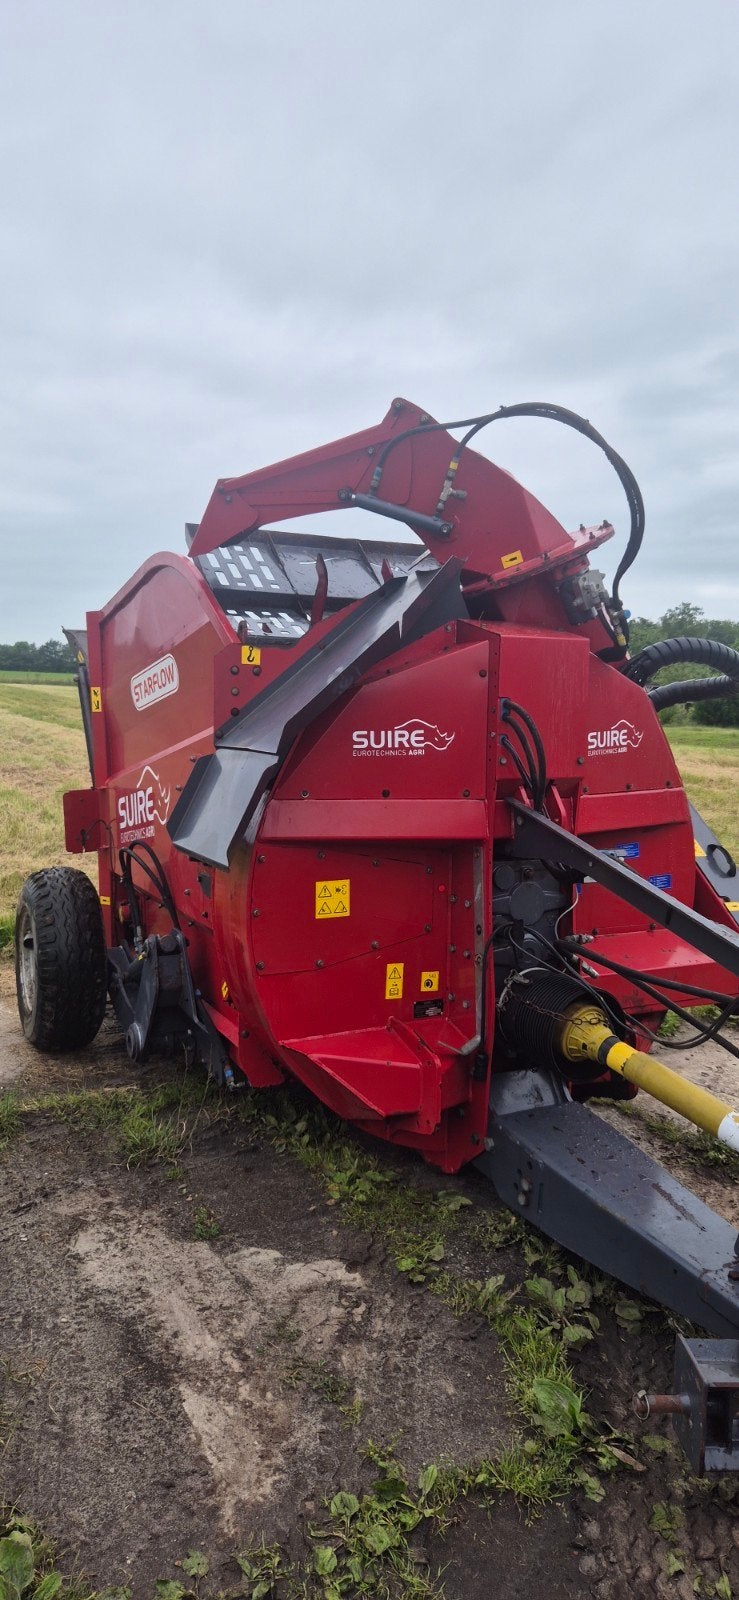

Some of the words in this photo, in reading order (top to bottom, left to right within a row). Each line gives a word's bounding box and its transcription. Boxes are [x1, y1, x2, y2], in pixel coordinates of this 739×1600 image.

[133, 663, 175, 703] STARFLOW
[352, 729, 425, 749] SUIRE
[587, 729, 628, 750] SUIRE
[118, 786, 154, 829] SUIRE
